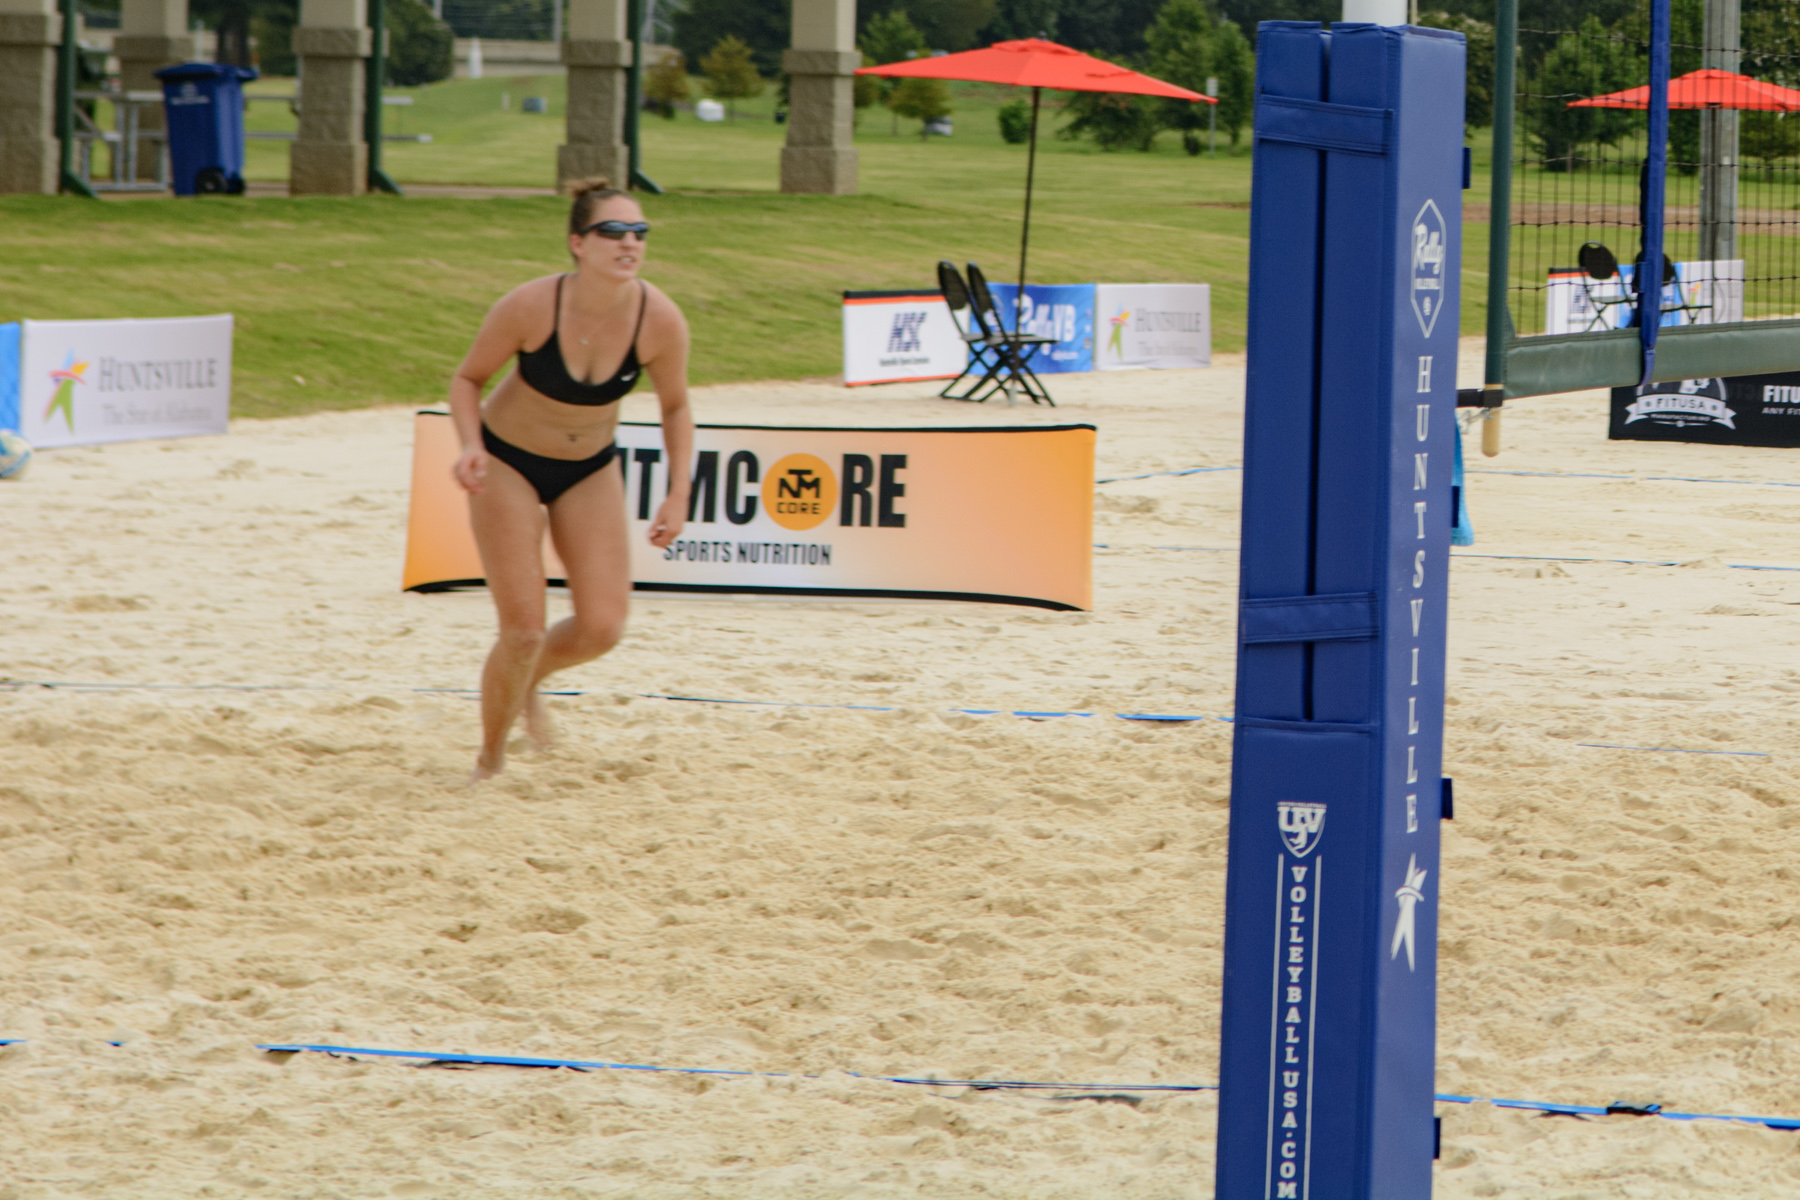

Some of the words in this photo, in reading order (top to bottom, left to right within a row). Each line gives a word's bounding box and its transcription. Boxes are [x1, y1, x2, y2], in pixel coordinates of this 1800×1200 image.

[98, 356, 218, 392] HUNTSVILLE
[1656, 398, 1706, 410] FITUSA
[1761, 407, 1786, 416] ANY
[777, 502, 822, 515] CORE
[663, 540, 732, 562] SPORTS
[736, 542, 832, 566] NUTRITION
[1406, 355, 1434, 834] HUNTSVILLE
